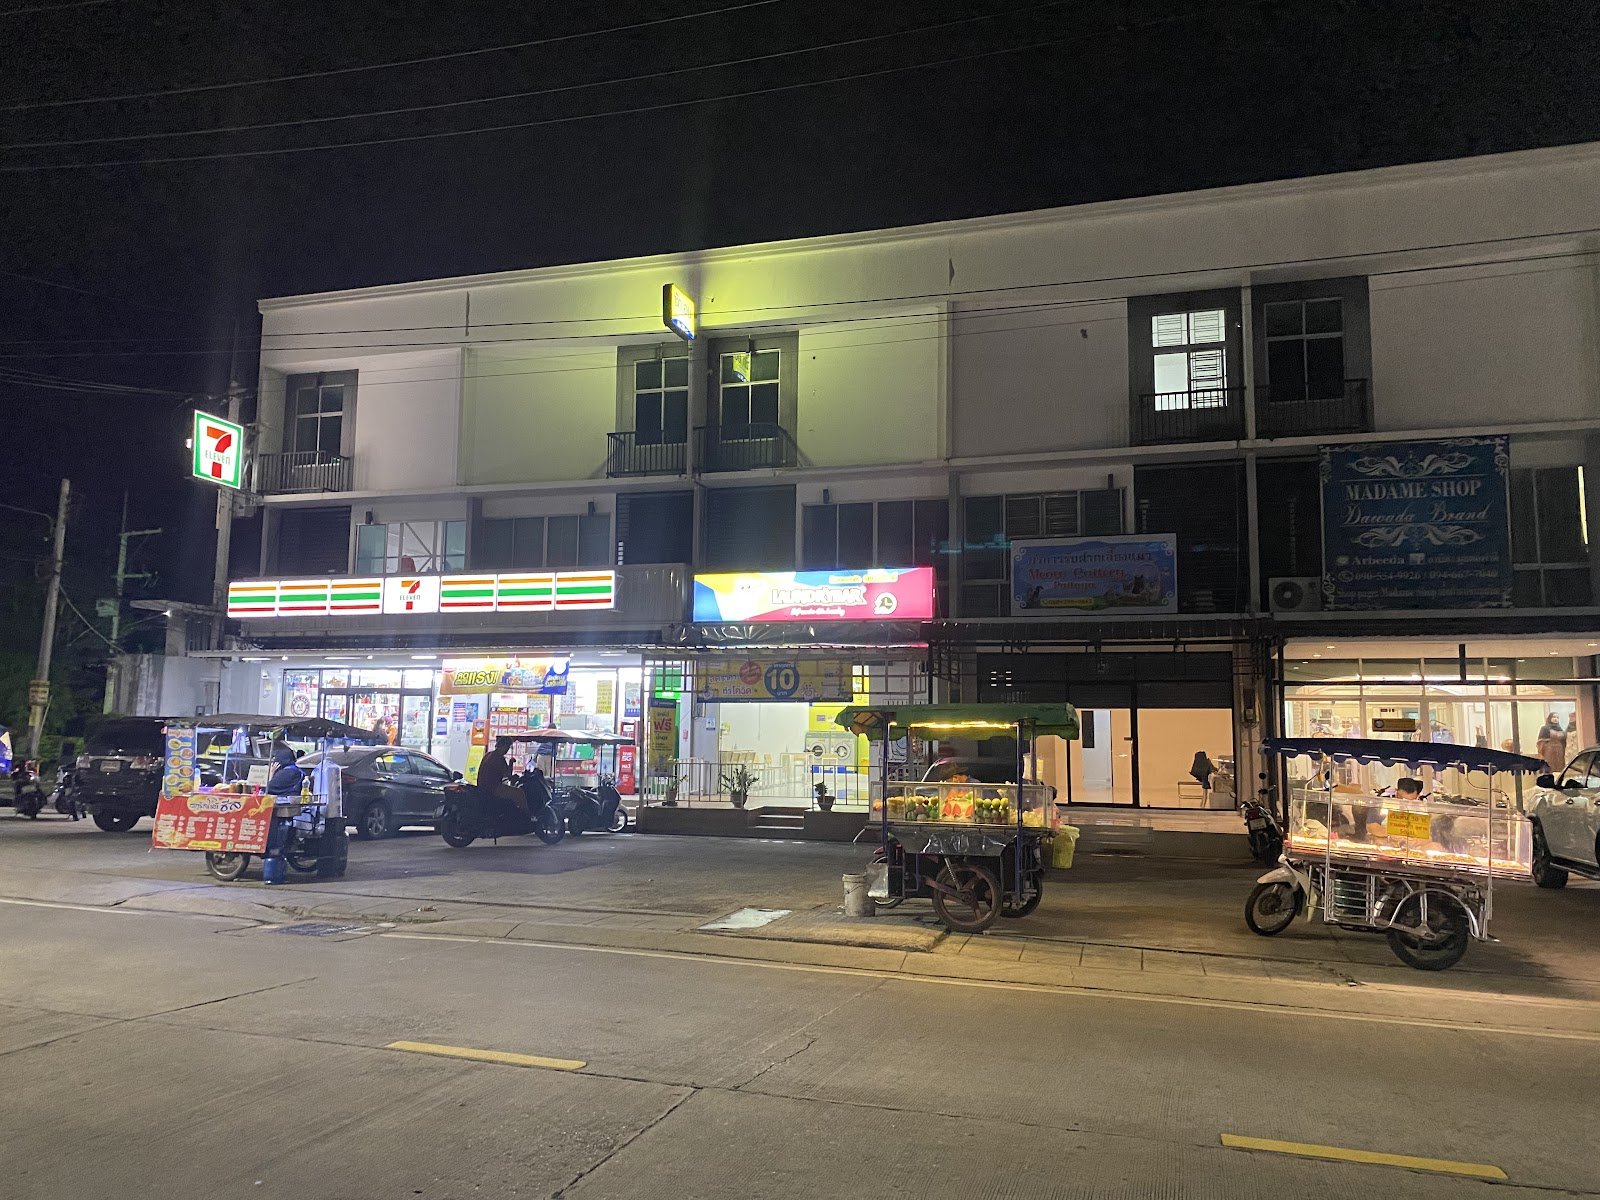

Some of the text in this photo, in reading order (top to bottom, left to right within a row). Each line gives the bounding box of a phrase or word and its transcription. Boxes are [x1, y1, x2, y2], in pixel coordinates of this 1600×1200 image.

[207, 426, 232, 479] 7
[1345, 479, 1482, 501] MADAME SHOP
[1428, 500, 1494, 523] Brand
[401, 580, 420, 610] 7
[767, 668, 795, 691] 10
